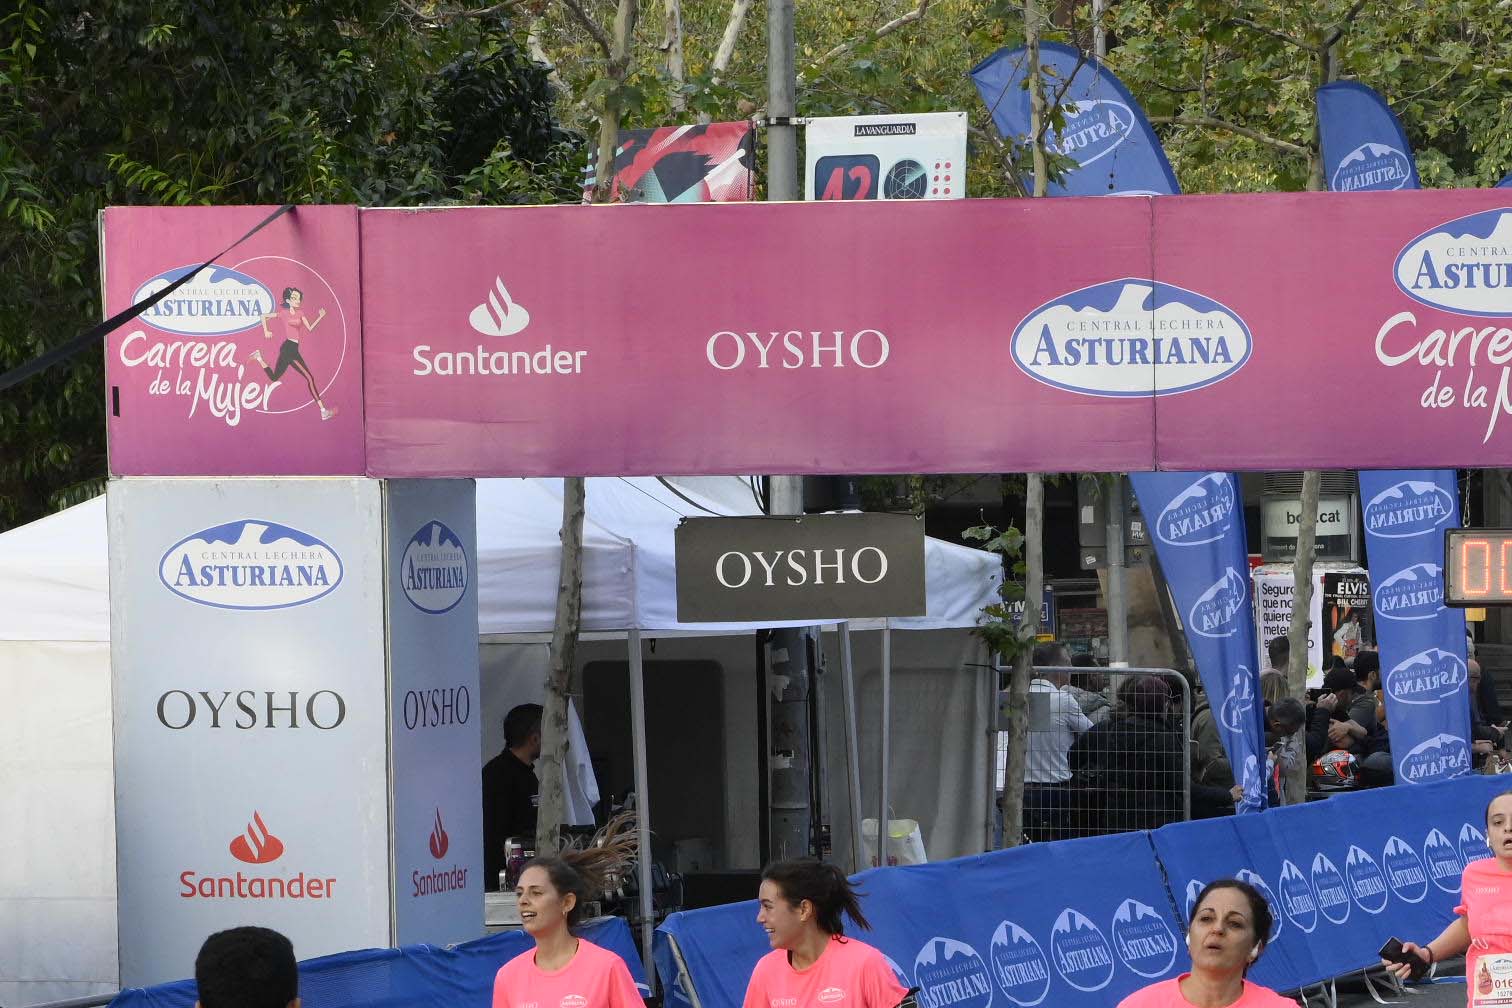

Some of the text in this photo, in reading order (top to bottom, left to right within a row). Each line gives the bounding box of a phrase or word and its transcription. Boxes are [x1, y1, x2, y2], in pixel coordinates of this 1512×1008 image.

[1066, 318, 1226, 332] CENTRAL LECHERA
[119, 330, 238, 368] Carrera
[412, 344, 588, 377] Santander
[706, 329, 890, 371] OYSHO
[1029, 323, 1233, 369] ASTURIANA
[149, 364, 283, 427] de la Mujer
[1420, 370, 1456, 408] de
[1463, 367, 1488, 408] la
[174, 553, 331, 589] ASTURIANA
[201, 551, 324, 561] CENTRAL LECHERA
[406, 556, 465, 591] ASTURIANA
[714, 545, 888, 590] OYSHO
[1263, 600, 1278, 611] que
[1337, 583, 1368, 595] ELVIS
[156, 689, 346, 730] OYSHO
[403, 685, 471, 730] OYSHO
[180, 870, 337, 899] Santander
[412, 864, 468, 898] Santander
[995, 956, 1048, 989] ASTURIANA
[1058, 940, 1112, 974] ASTURIANA
